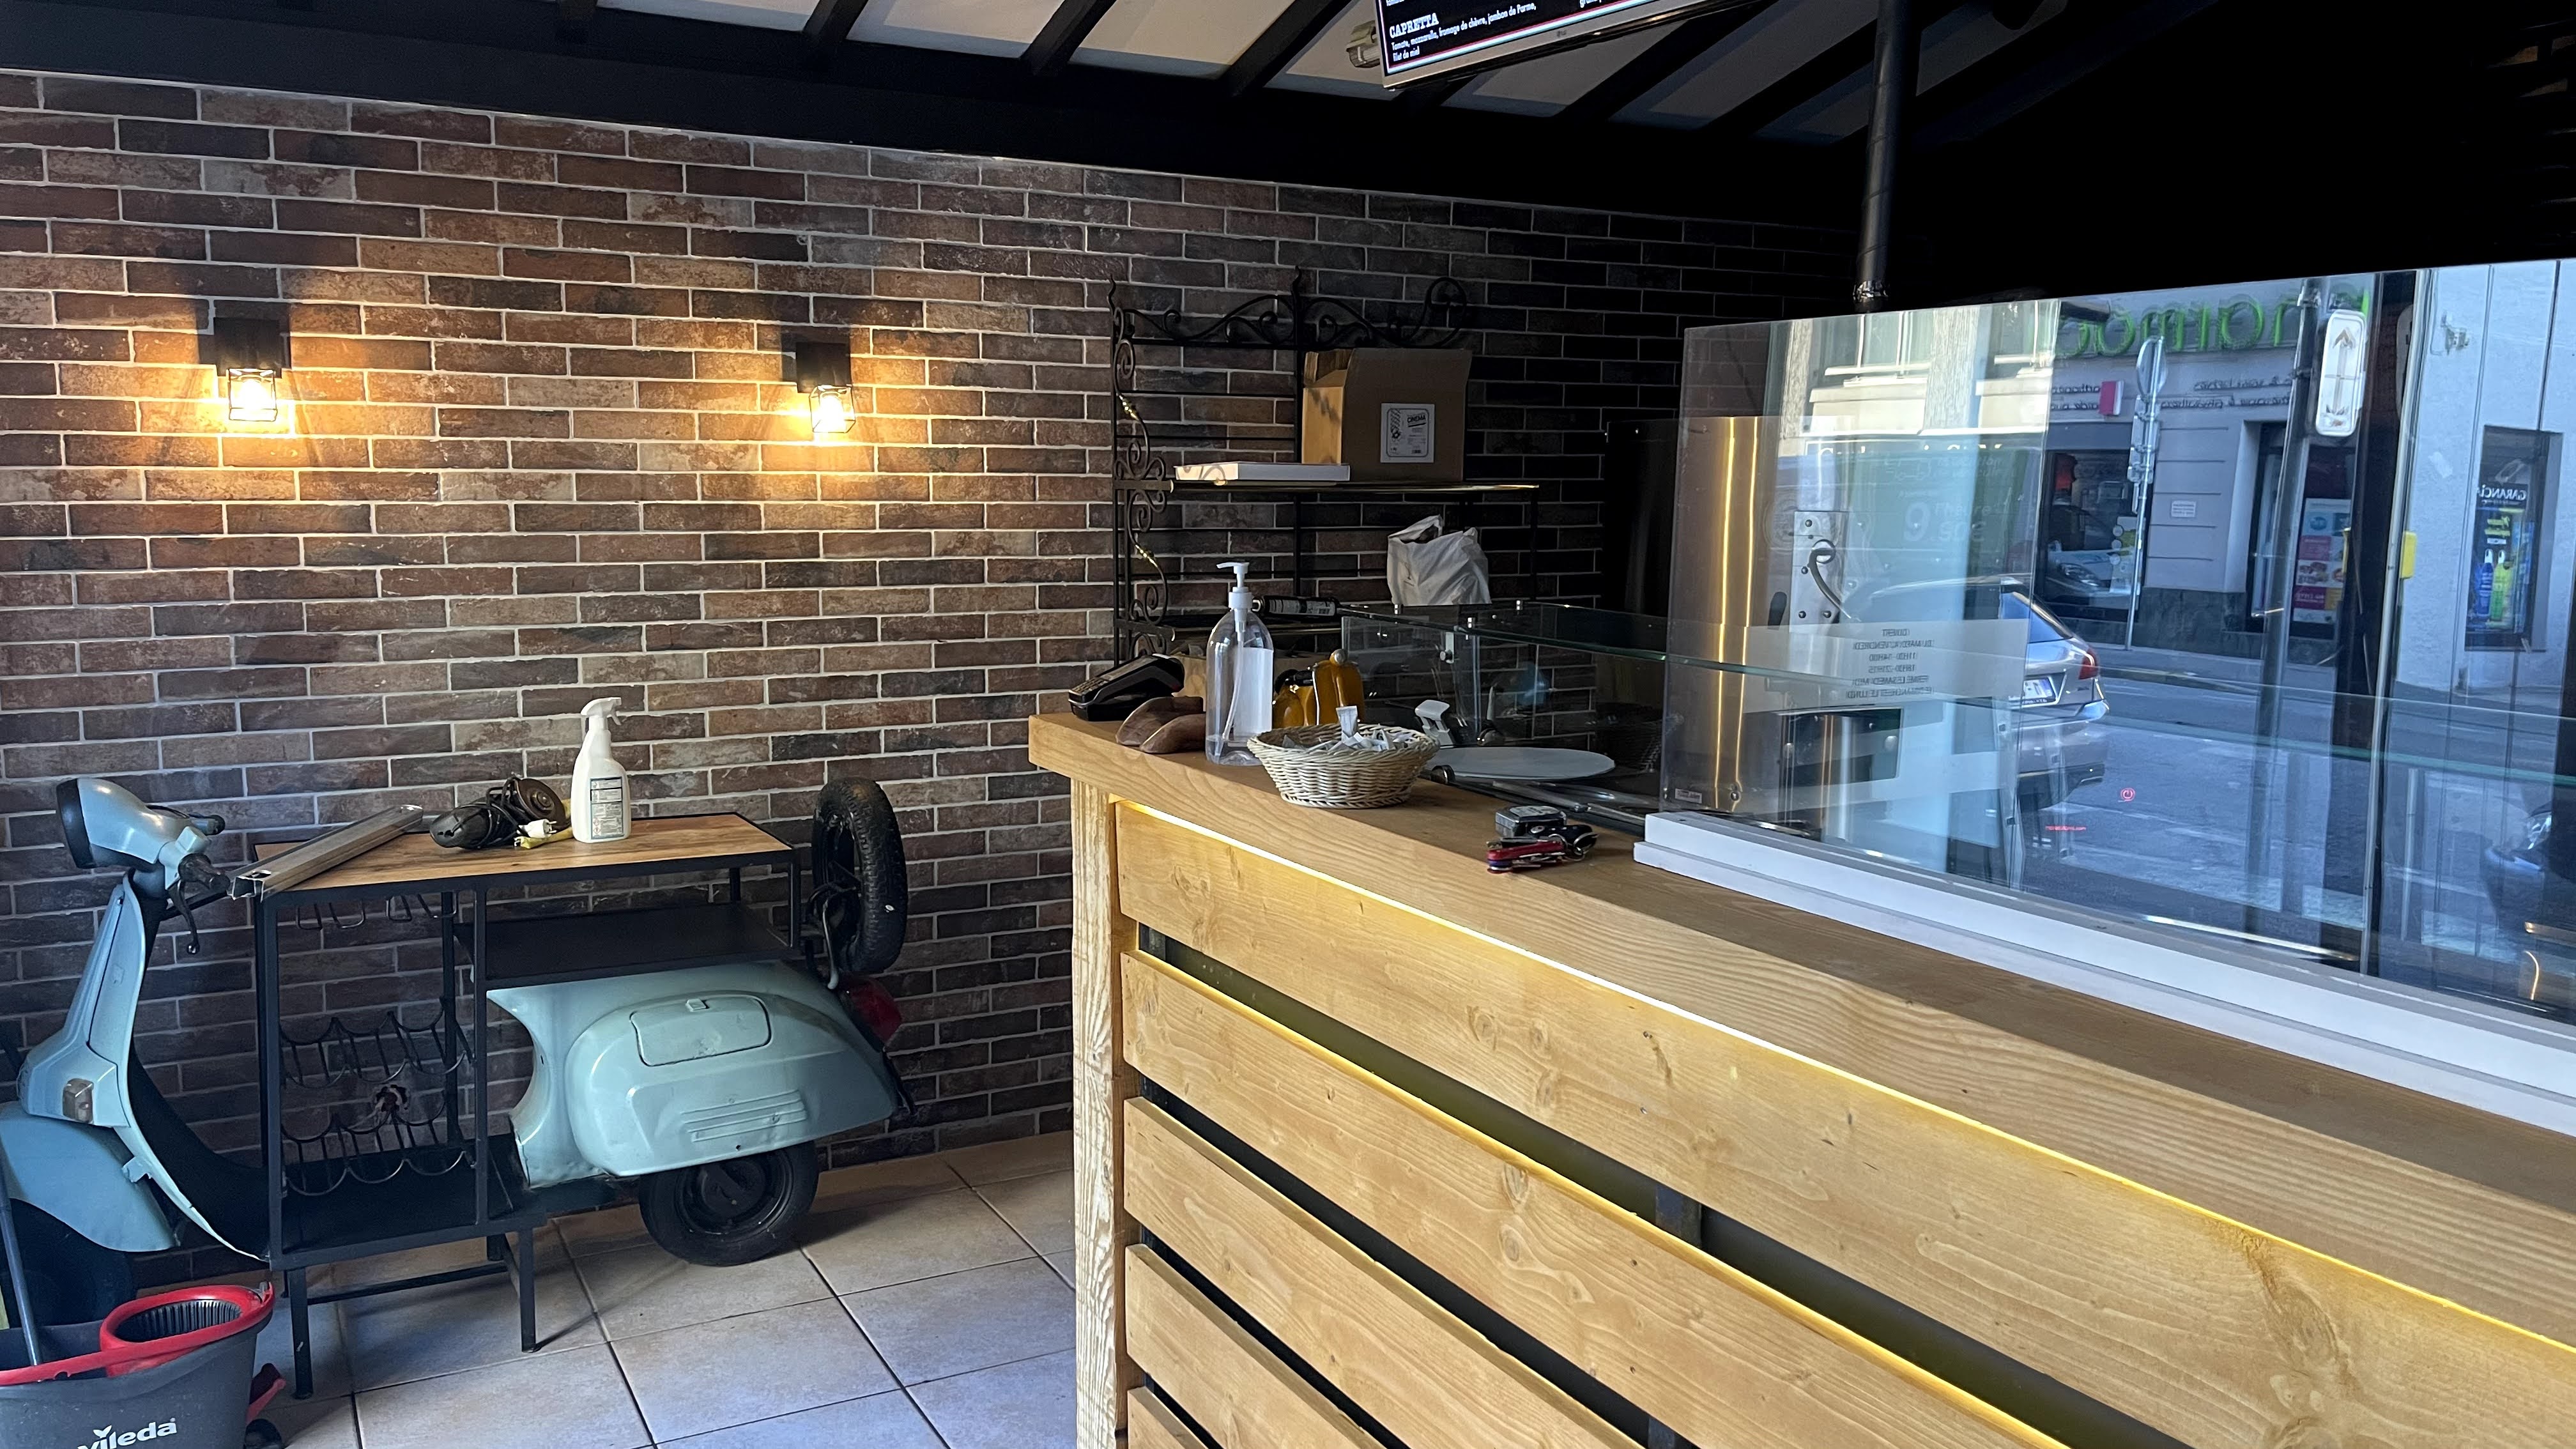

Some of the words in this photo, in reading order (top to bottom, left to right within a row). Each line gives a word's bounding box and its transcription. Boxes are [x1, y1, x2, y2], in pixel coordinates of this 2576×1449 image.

[1390, 12, 1439, 38] CAPRETTA
[1392, 40, 1410, 50] Tomate,
[1439, 25, 1460, 36] fromage
[1460, 20, 1468, 31] de
[1487, 10, 1508, 25] jambon
[1508, 6, 1516, 16] de
[1517, 3, 1537, 14] Parme,
